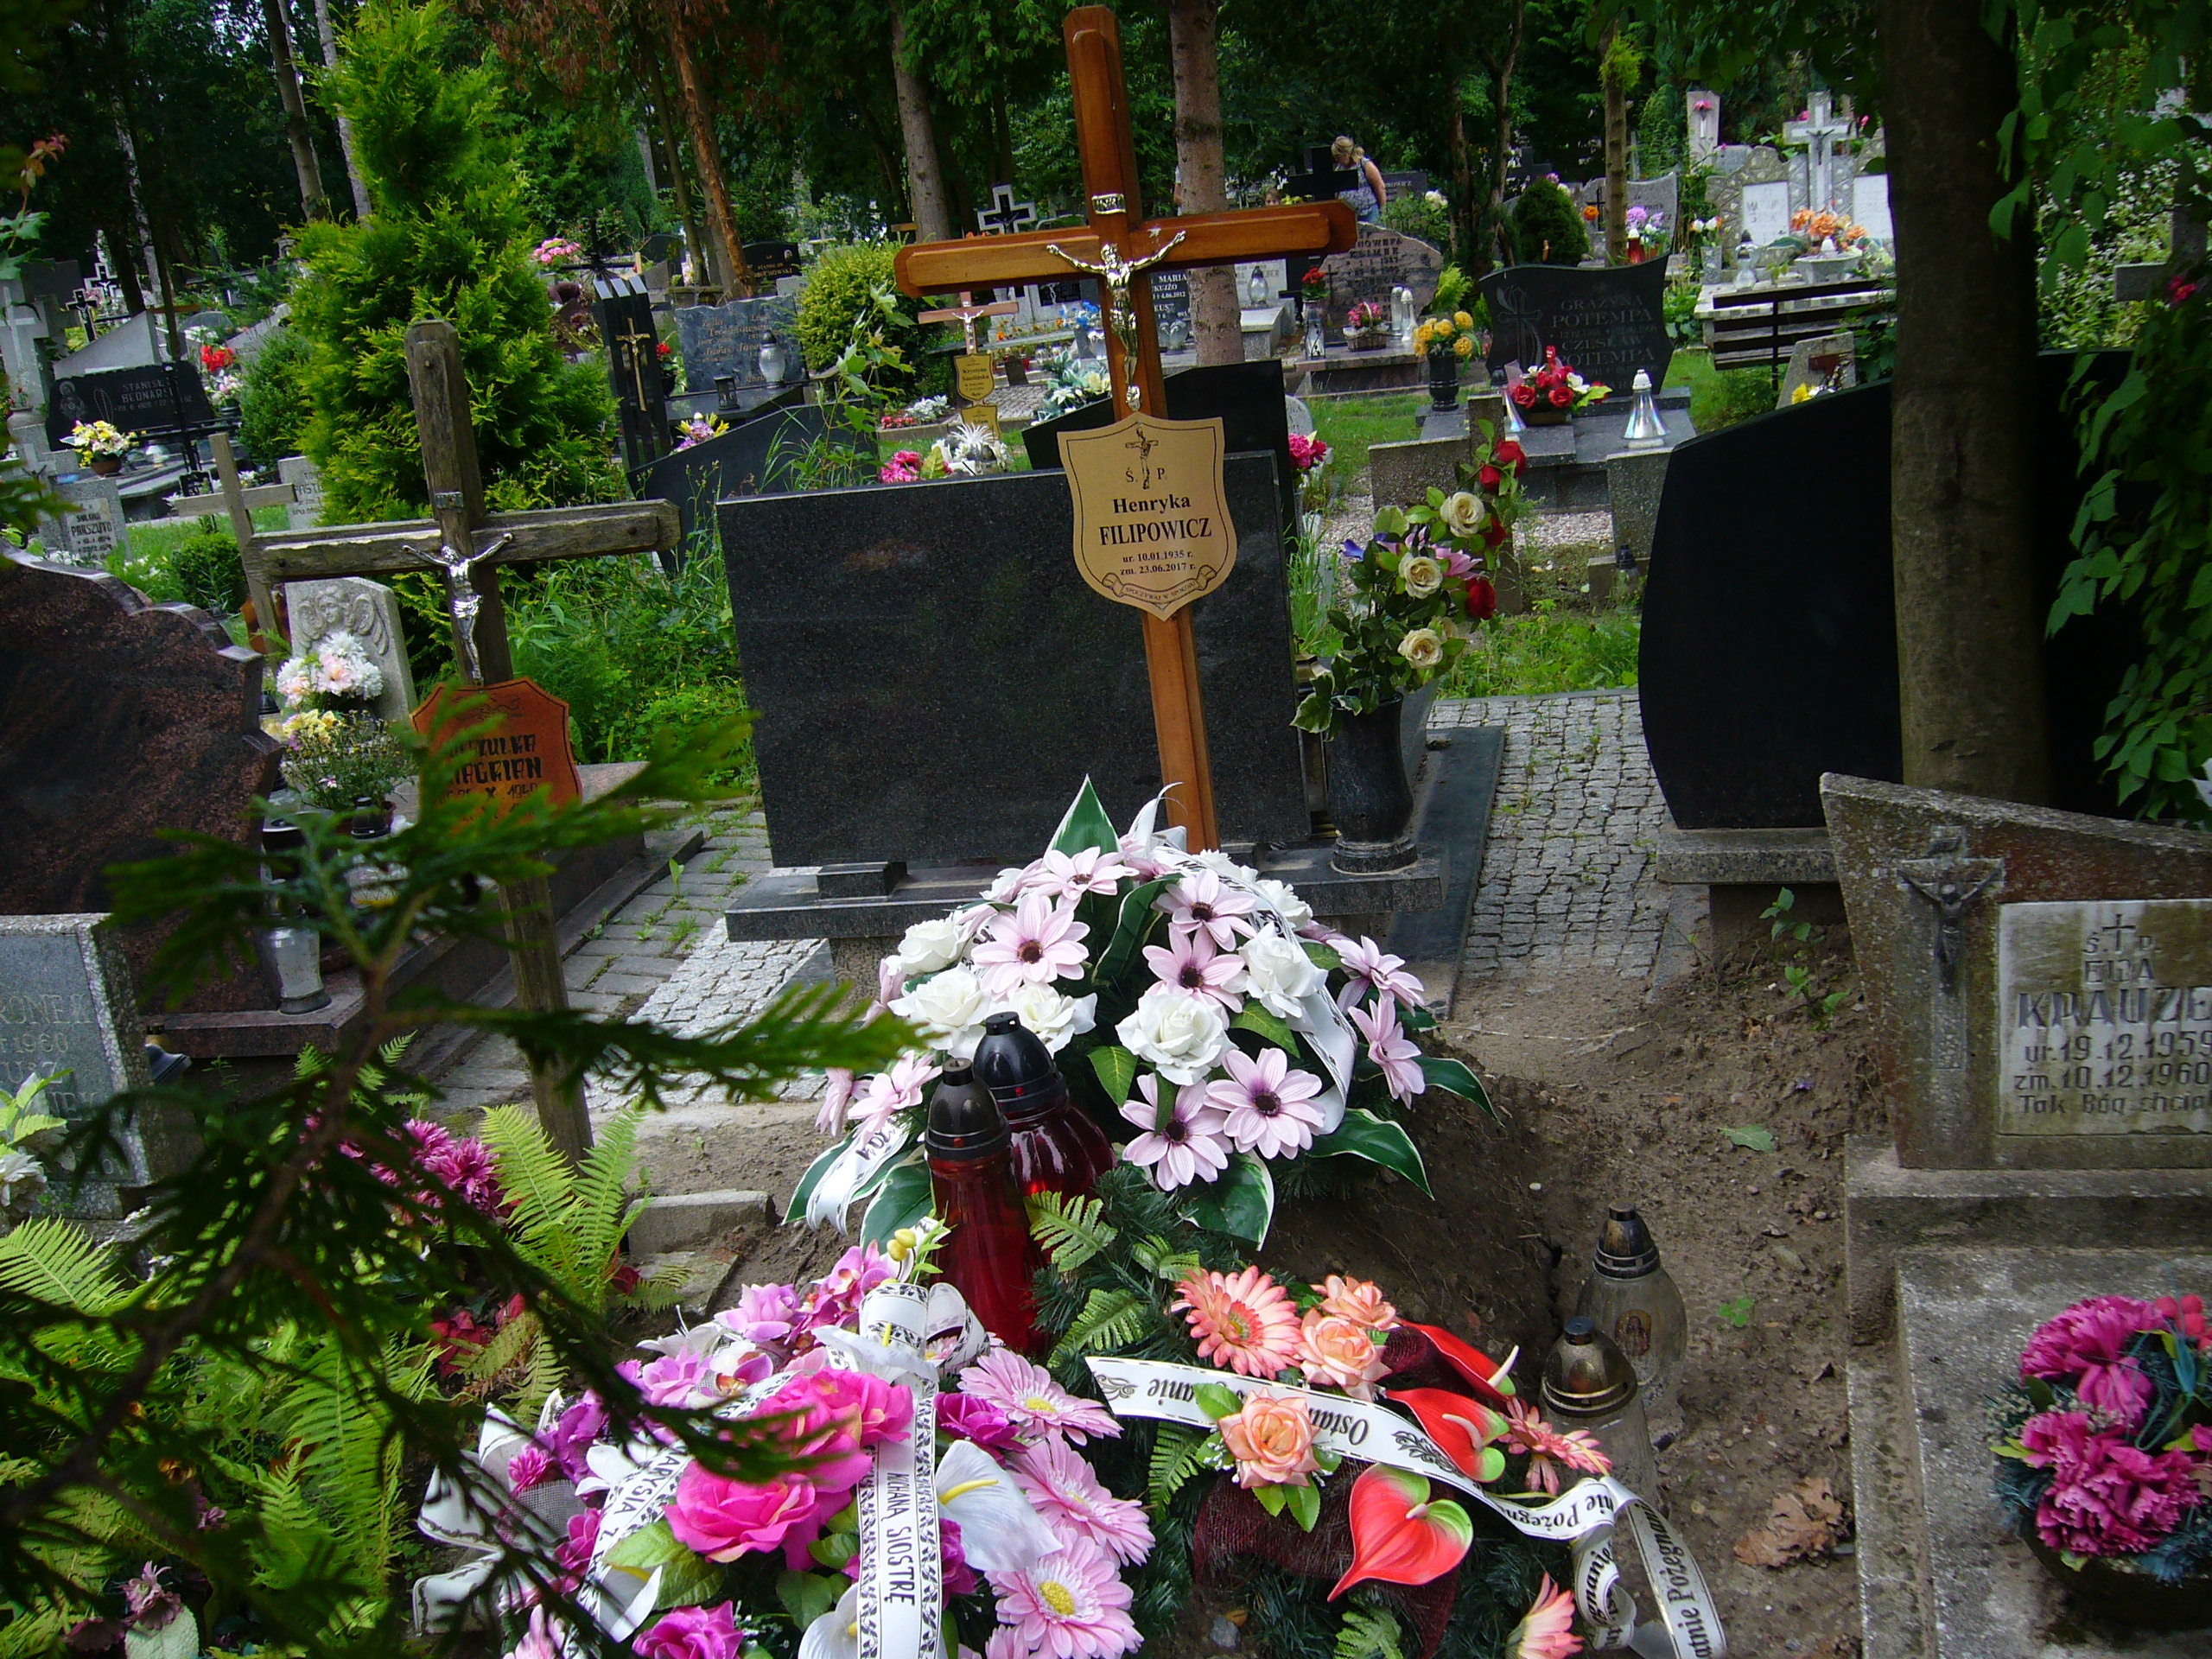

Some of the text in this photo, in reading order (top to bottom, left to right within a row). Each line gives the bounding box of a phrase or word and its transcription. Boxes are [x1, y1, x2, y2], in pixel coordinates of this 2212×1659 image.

[1552, 308, 1653, 328] POTEMPA
[1112, 493, 1192, 514] Henryka
[1099, 518, 1212, 545] FILIPOWICZ
[1122, 555, 1135, 563] ur.
[1137, 550, 1185, 563] 10.01.1935
[1119, 568, 1136, 576] zm.
[1139, 563, 1187, 574] 23.06.2017
[2018, 985, 2212, 1028] KRAUZE
[2018, 1094, 2066, 1114] Tak
[884, 1526, 916, 1606] SIOSTRĘ
